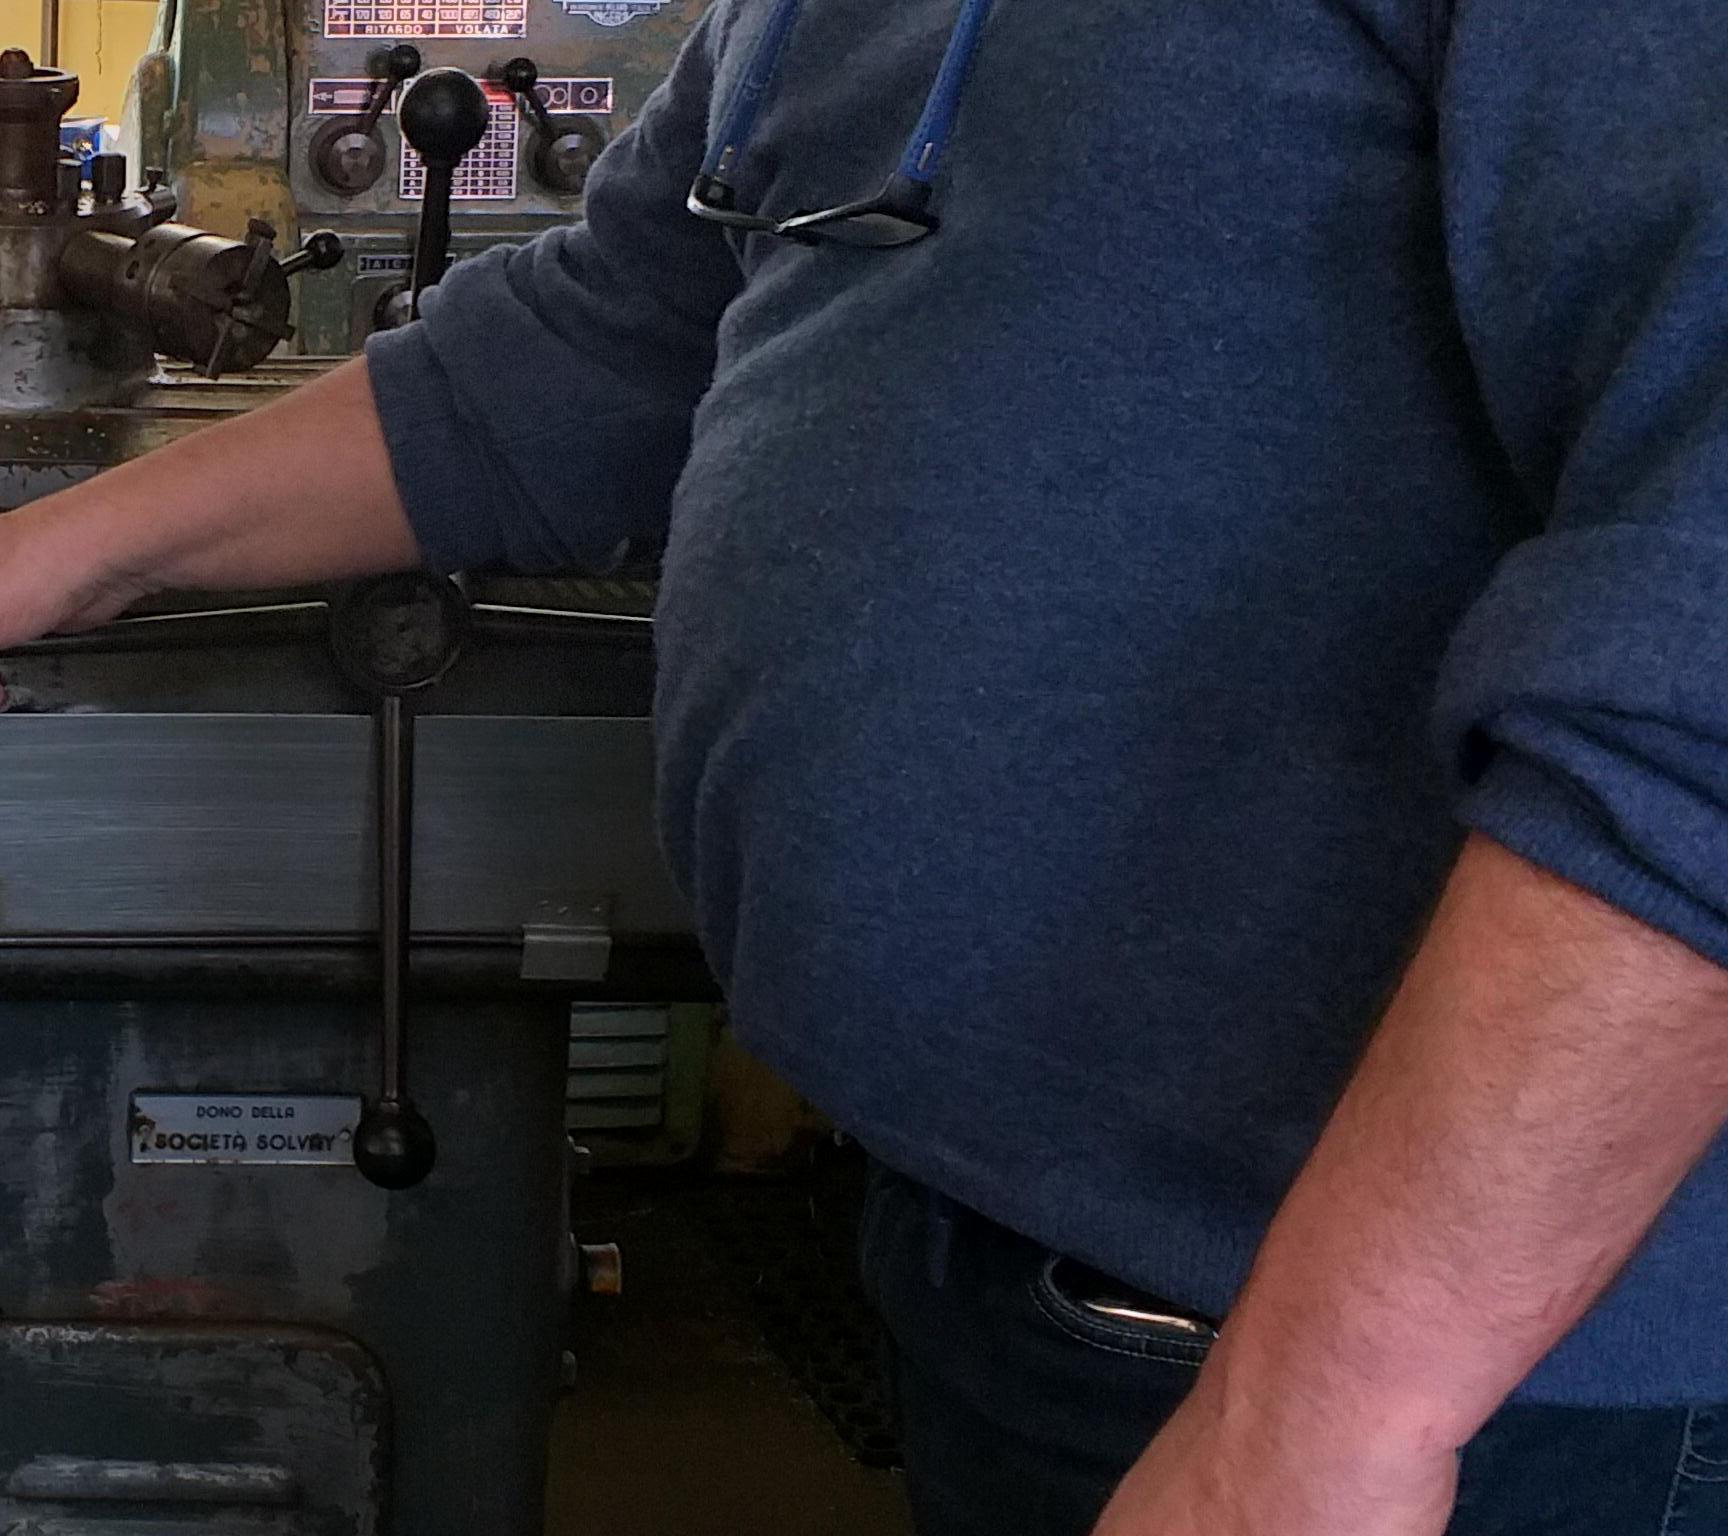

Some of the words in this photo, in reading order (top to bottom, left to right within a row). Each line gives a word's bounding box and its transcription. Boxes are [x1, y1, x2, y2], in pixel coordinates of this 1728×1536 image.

[365, 24, 423, 34] RITARDO
[455, 24, 509, 35] VOLATA
[196, 1105, 243, 1119] DONO
[252, 1105, 295, 1119] DELLA
